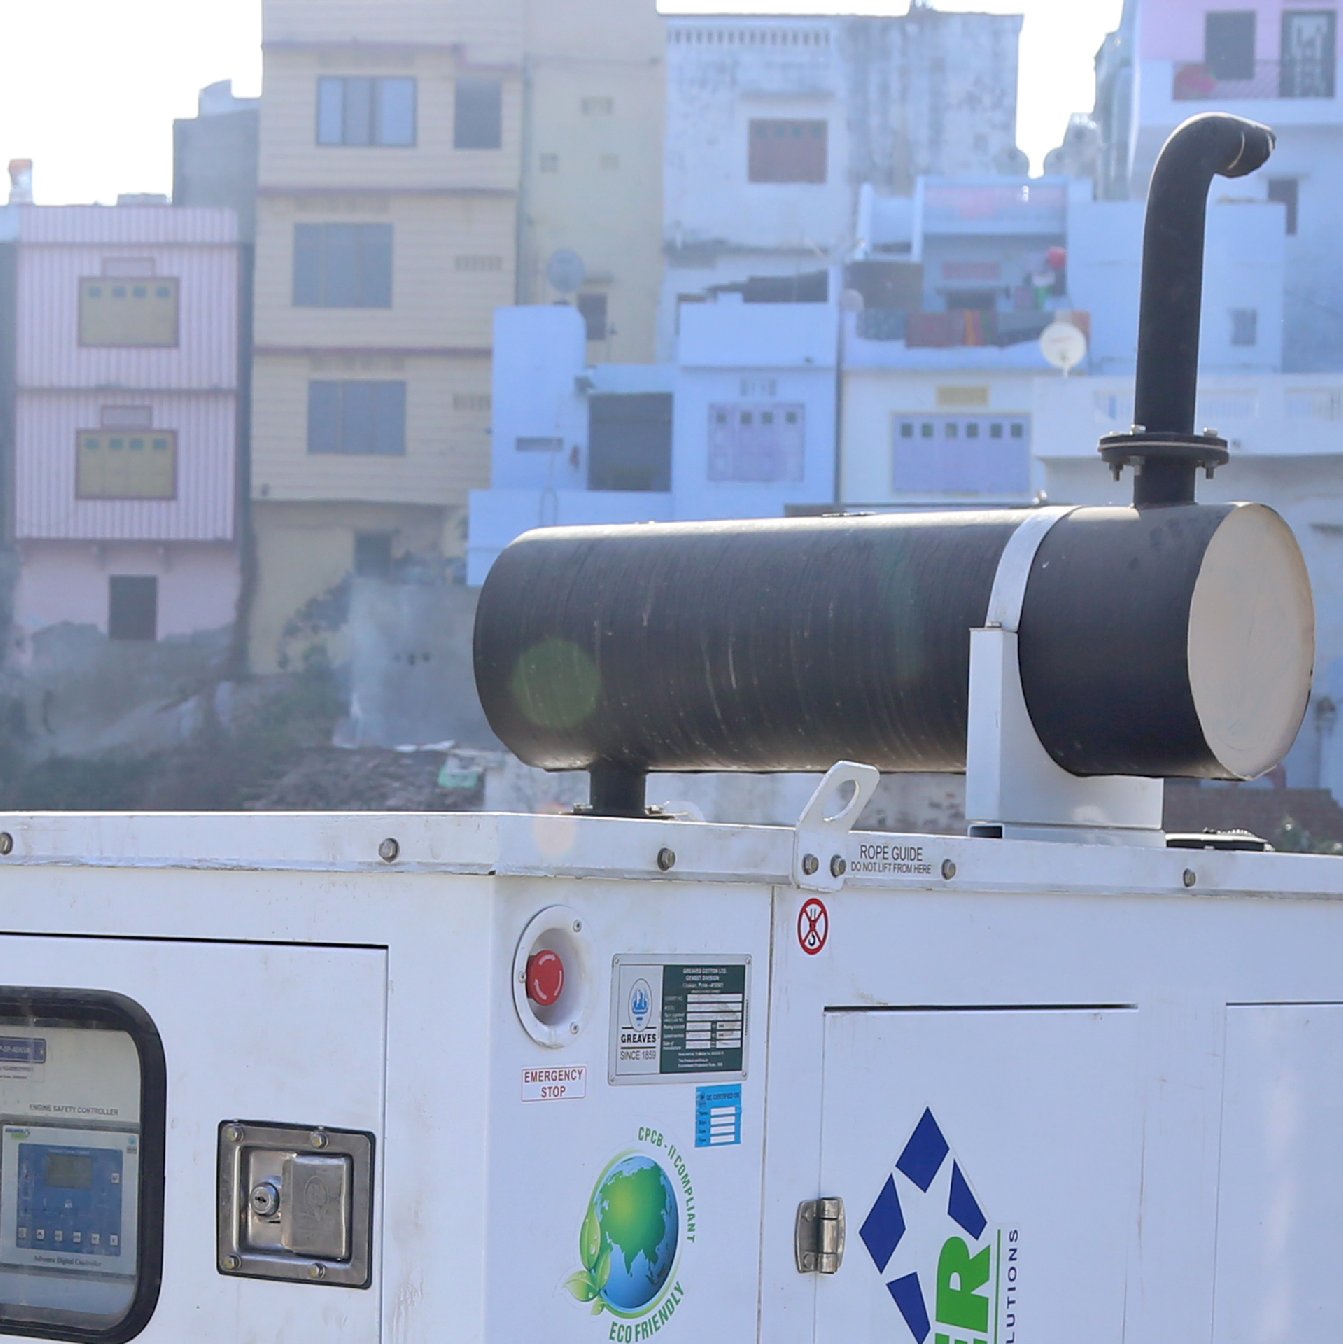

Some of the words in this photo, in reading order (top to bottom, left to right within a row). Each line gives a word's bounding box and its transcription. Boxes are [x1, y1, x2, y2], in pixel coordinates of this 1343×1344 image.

[860, 844, 889, 860] ROPE
[891, 846, 923, 861] GUIDE
[851, 861, 861, 872] DO
[862, 861, 878, 872] NOT
[878, 862, 892, 873] LIFT
[893, 863, 912, 873] FROM
[913, 864, 931, 874] HERE
[621, 1033, 657, 1043] GREAVES
[620, 1050, 641, 1060] SINCE
[523, 1068, 583, 1083] EMERGENCY
[541, 1086, 567, 1098] STOP
[53, 1105, 76, 1113] SAFETY
[77, 1106, 119, 1116] CONTROLLER
[637, 1126, 664, 1147] CPCB
[674, 1155, 696, 1243] COMPLIANT
[609, 1320, 632, 1344] ECO
[635, 1281, 685, 1342] FRIENDLY
